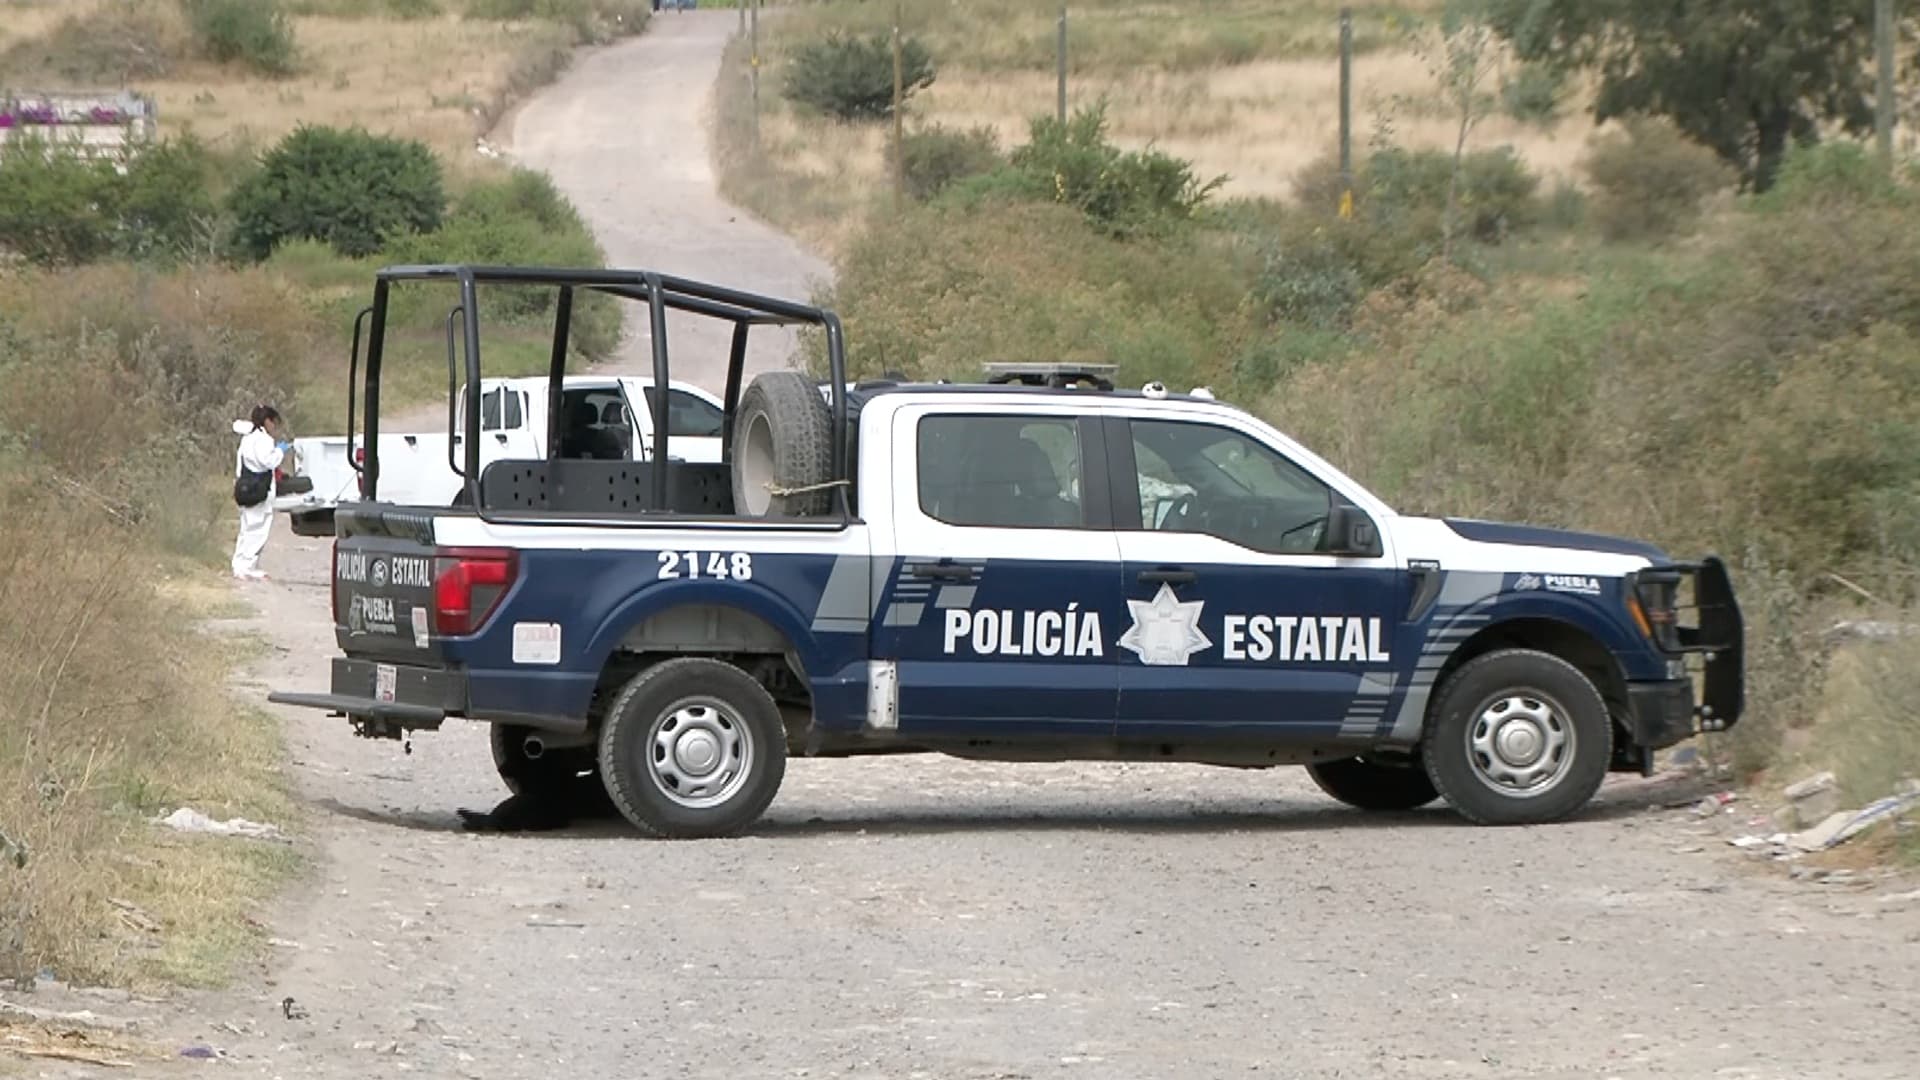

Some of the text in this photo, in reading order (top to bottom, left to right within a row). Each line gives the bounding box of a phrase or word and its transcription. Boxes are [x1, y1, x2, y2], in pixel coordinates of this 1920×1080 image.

[336, 546, 431, 588] POLICÍA ESTATAL
[657, 550, 752, 581] 2148
[1544, 574, 1601, 590] PUEBLA
[362, 595, 395, 623] PUEBLA
[943, 602, 1390, 662] POLICÍA ESTATAL
